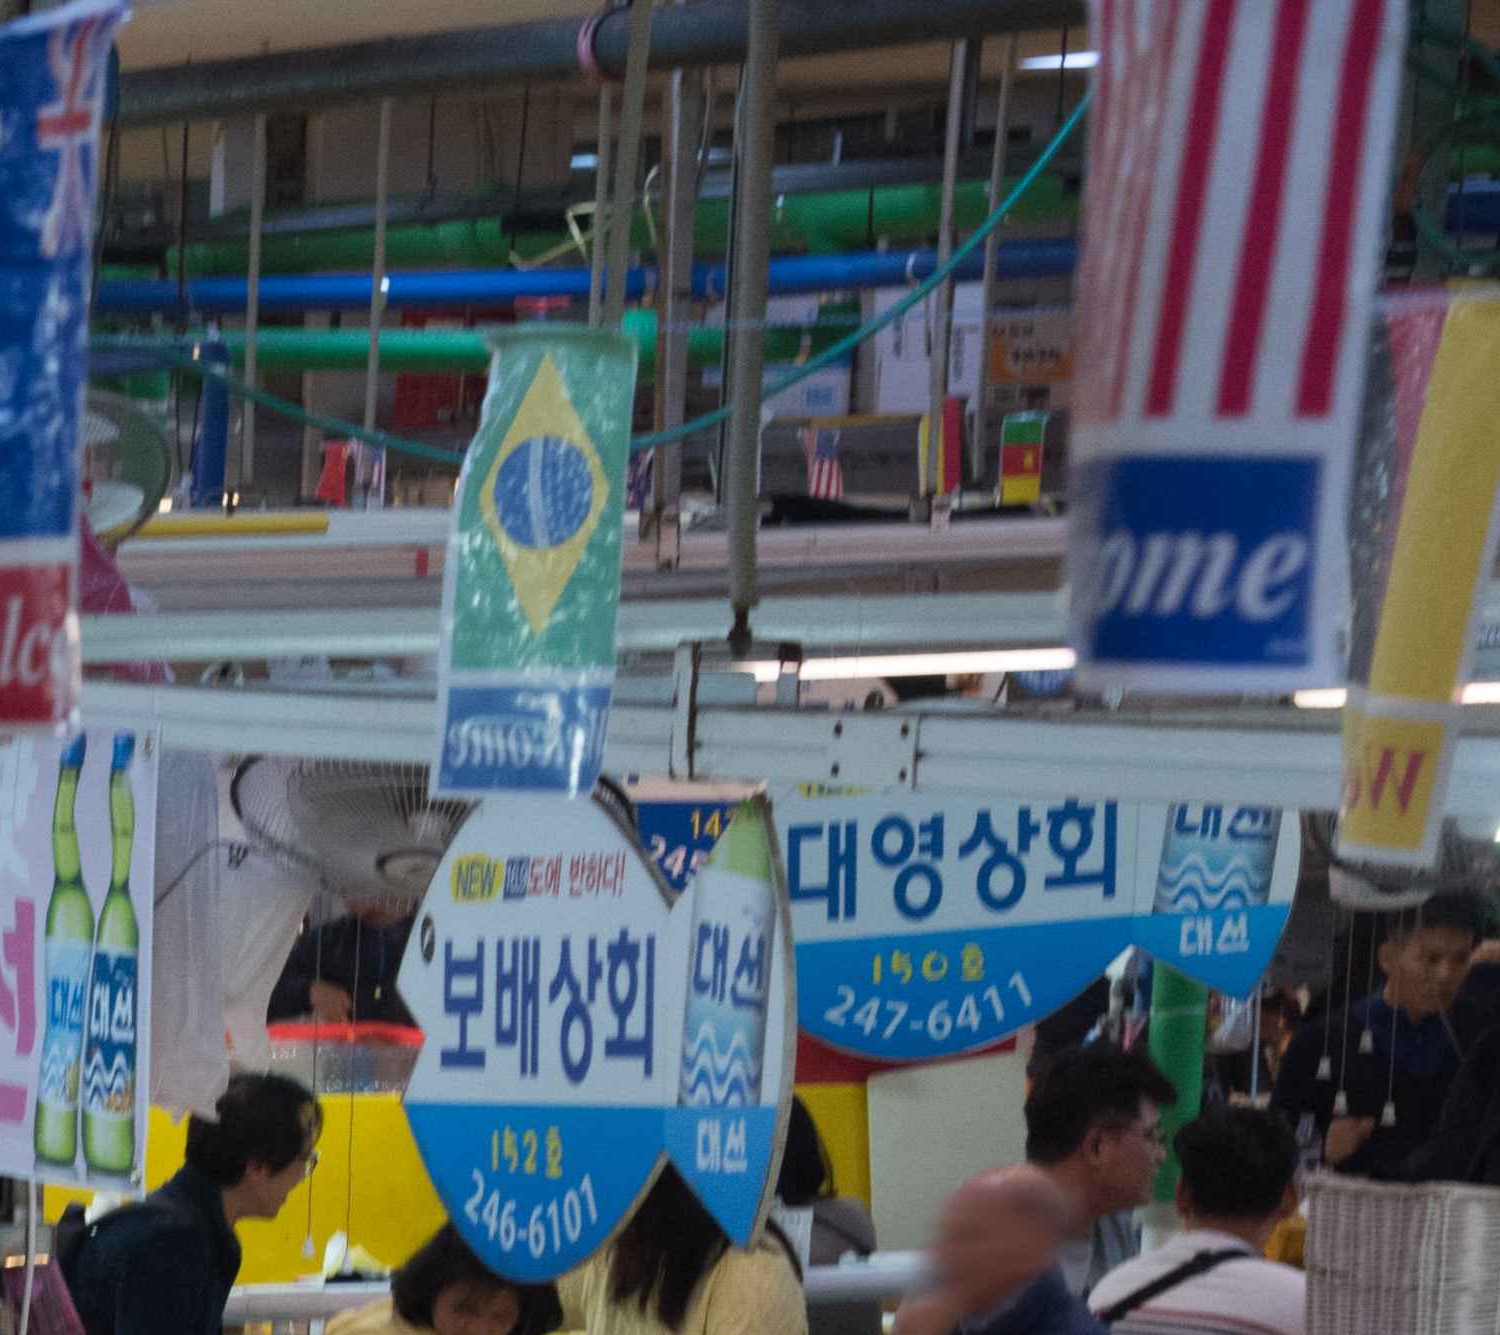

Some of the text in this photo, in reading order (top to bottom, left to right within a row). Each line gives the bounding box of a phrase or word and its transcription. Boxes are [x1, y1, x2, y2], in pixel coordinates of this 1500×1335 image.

[788, 798, 1118, 922] 대영상회
[692, 921, 767, 1011] 대선
[1180, 910, 1250, 958] 대선
[91, 980, 134, 1041] 대선
[440, 925, 657, 1085] 보배상회
[825, 970, 1033, 1042] 247-6411
[695, 1117, 748, 1173] 대선
[463, 1167, 599, 1259] 246-6101
